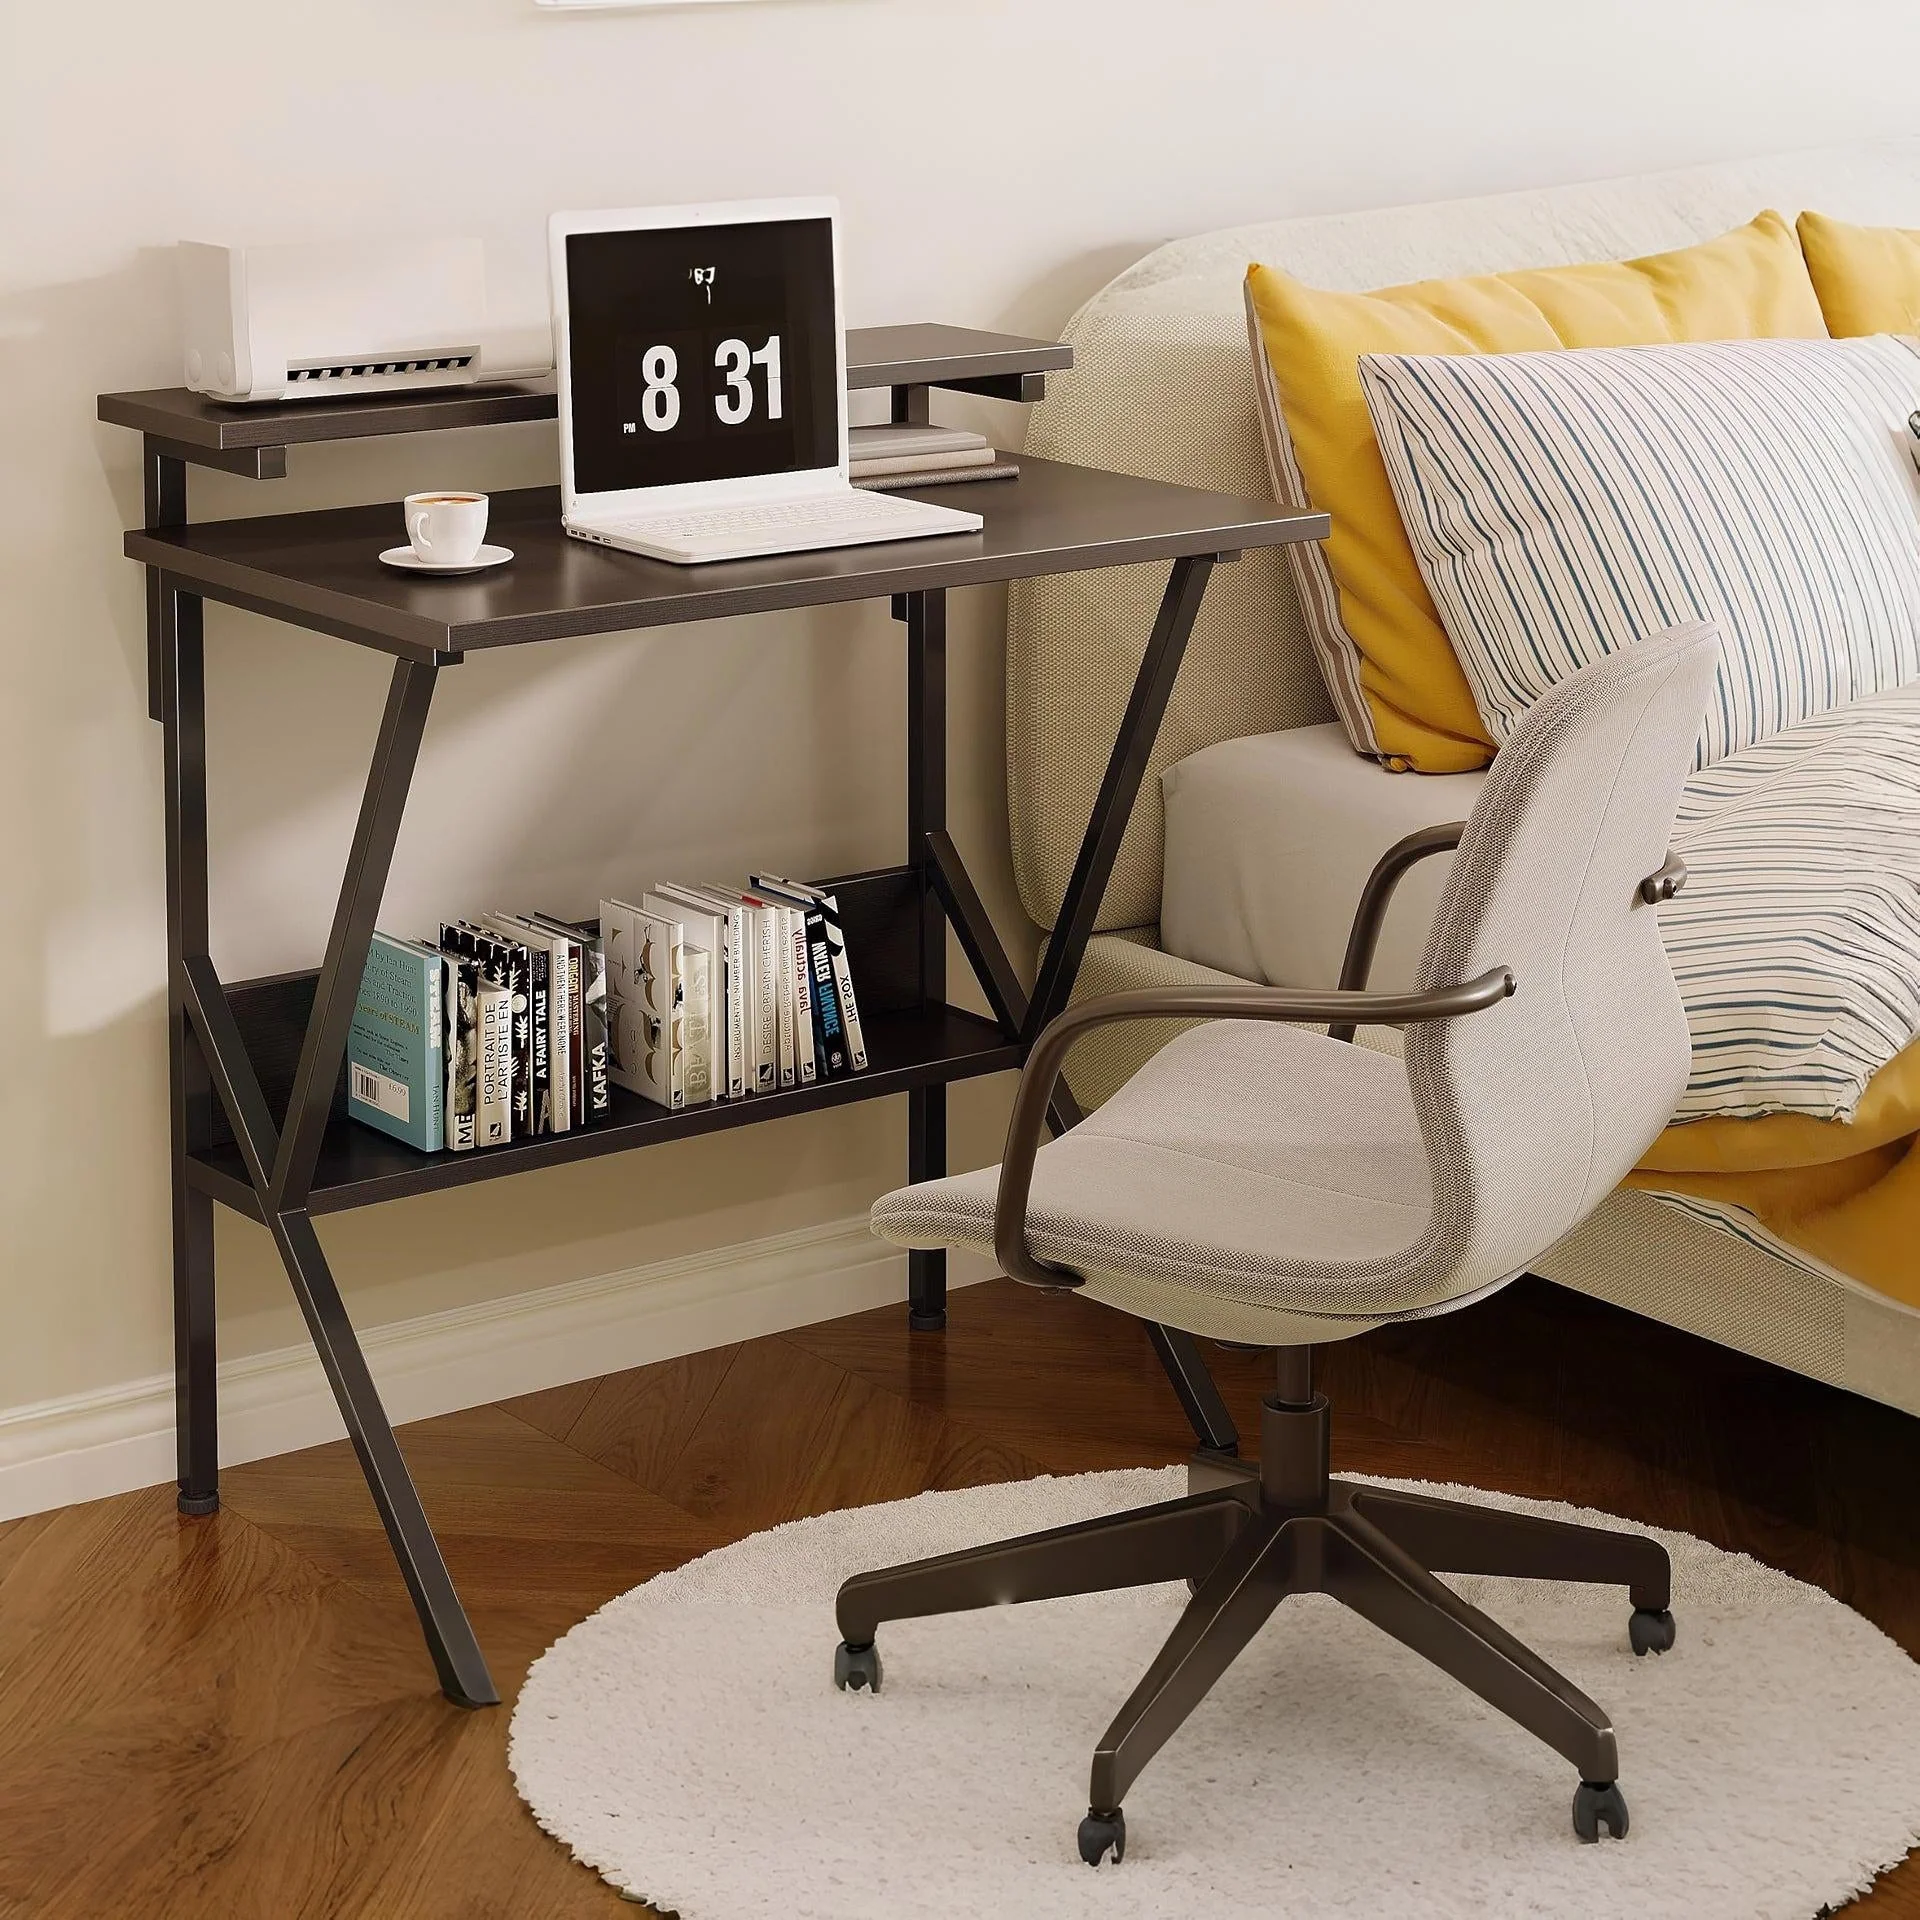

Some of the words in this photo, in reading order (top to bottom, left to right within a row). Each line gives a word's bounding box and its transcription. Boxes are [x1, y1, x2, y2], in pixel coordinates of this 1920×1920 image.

[642, 345, 680, 432] 8
[714, 335, 782, 425] 31
[623, 423, 636, 433] PM
[733, 914, 741, 956] BUILDING
[762, 919, 772, 968] CHERISH
[556, 953, 566, 970] AND
[556, 970, 566, 989] THEN
[733, 957, 741, 994] NUMBER
[498, 999, 509, 1020] EN
[535, 989, 547, 1025] TALE
[556, 990, 566, 1014] THERE
[762, 970, 772, 1014] OBTAIN
[484, 1003, 496, 1024] DE
[557, 1015, 567, 1036] WERE
[733, 995, 741, 1062] INSTRUMENTAL
[535, 1027, 547, 1067] FAIRY
[557, 1036, 567, 1056] NONE
[762, 1015, 772, 1054] DESIRE
[484, 1029, 495, 1105] PORTRAIT
[536, 1067, 547, 1079] A
[591, 1041, 608, 1109] KAFKA
